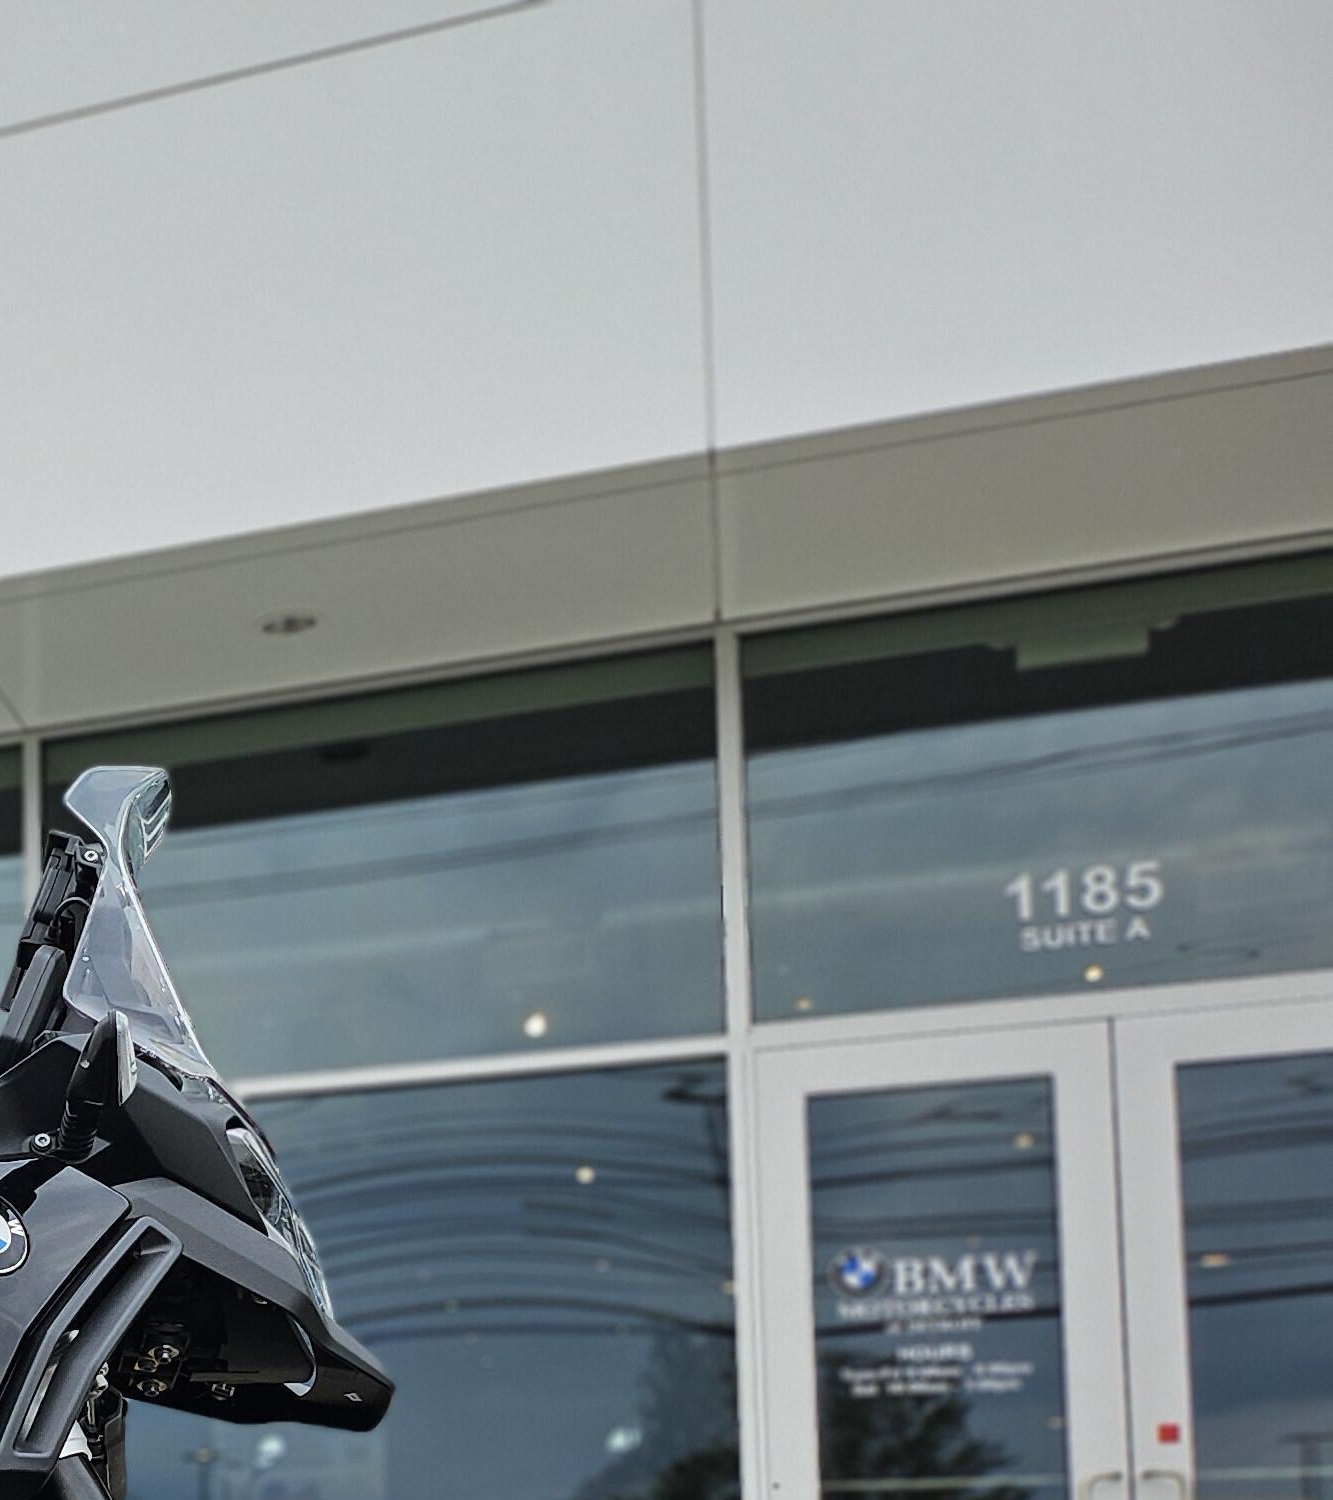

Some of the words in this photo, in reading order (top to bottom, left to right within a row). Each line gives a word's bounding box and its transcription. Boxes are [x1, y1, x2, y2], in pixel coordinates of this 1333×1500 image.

[1004, 860, 1163, 920] 1185
[1020, 917, 1117, 952] SUITE
[1126, 914, 1151, 941] A
[892, 1250, 1037, 1295] BMW
